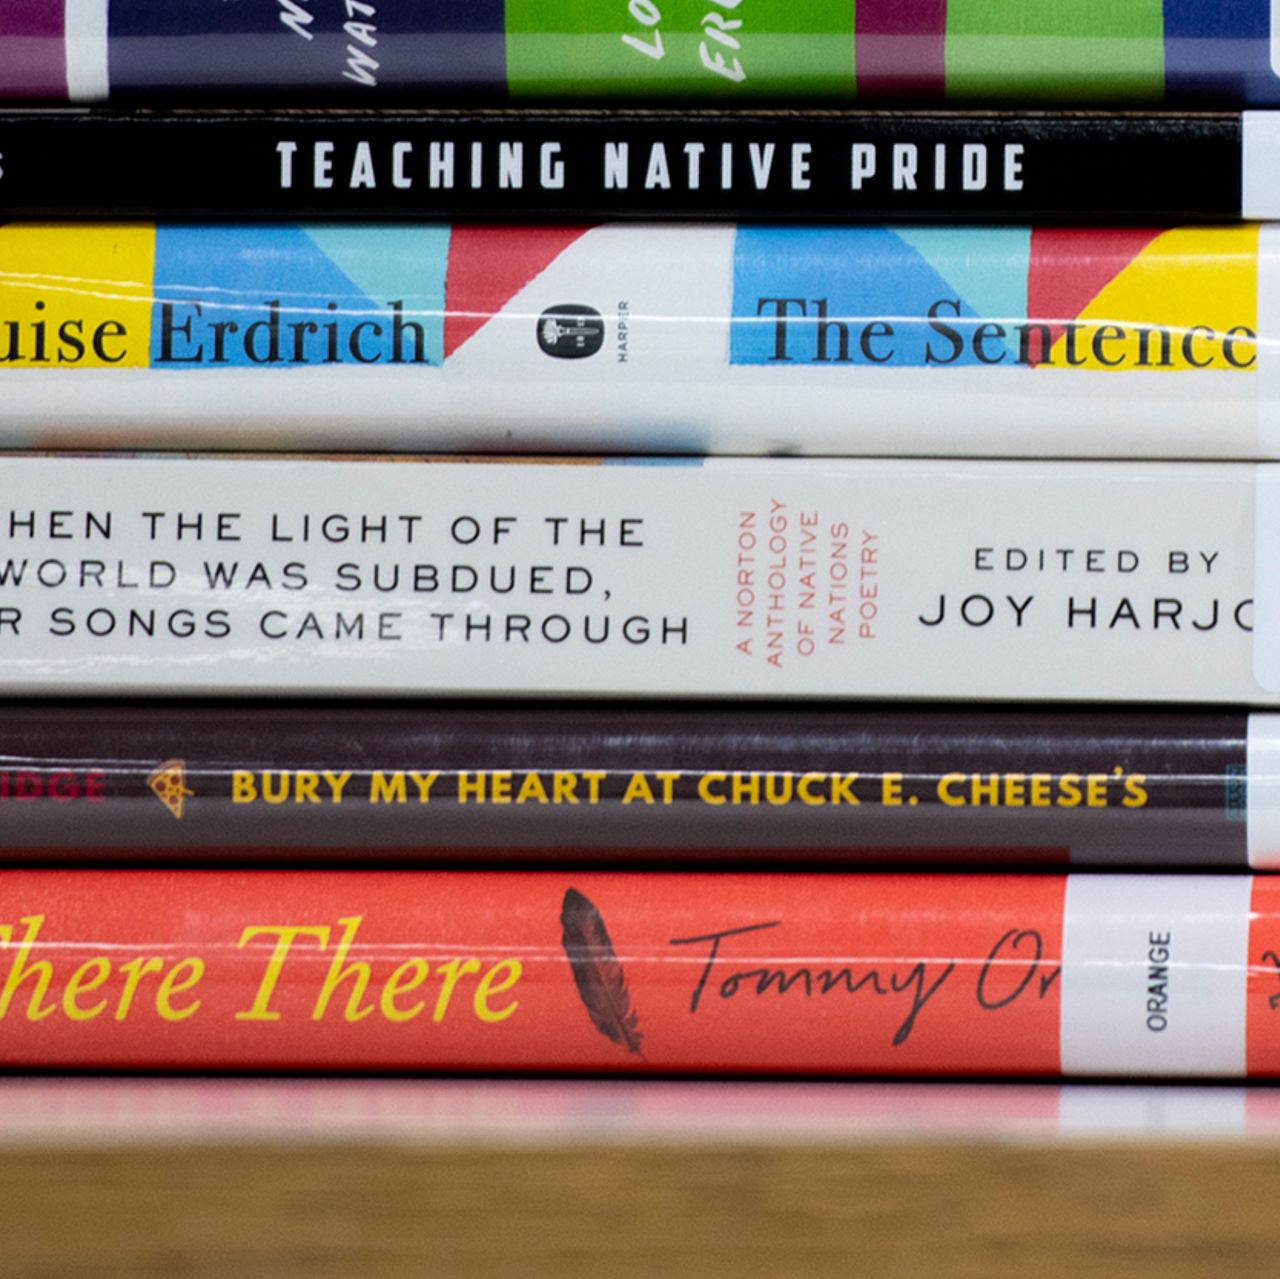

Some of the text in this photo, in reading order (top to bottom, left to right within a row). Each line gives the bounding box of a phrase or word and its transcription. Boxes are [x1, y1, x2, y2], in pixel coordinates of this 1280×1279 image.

[277, 141, 1026, 191] TEACHING NATIVE PRIDE
[152, 299, 429, 367] Erdrich
[617, 301, 629, 362] HARPER
[757, 299, 1258, 370] The Sentence
[142, 512, 243, 542] THE
[271, 514, 422, 544] LIGHT
[451, 516, 517, 545] OF
[544, 517, 644, 547] THE
[974, 547, 1220, 574] EDITED BY
[204, 561, 308, 591] WAS
[337, 564, 613, 602] SUBDUED,
[737, 511, 755, 657] A NORTON
[767, 498, 787, 668] ANTHOLOGY
[797, 511, 819, 657] OF NATIVE
[829, 522, 850, 645] NATIONS
[859, 529, 880, 640] POETRY
[918, 593, 1035, 628] JOY
[49, 608, 232, 638] SONGS
[260, 611, 403, 641] CAME
[430, 613, 688, 644] THROUGH
[232, 765, 1148, 809] BURY MY HEART AT CHUCK E. CHEESE'S
[235, 915, 522, 1025] There
[670, 920, 956, 1047] Tommy
[1147, 931, 1170, 1032] ORANGE
